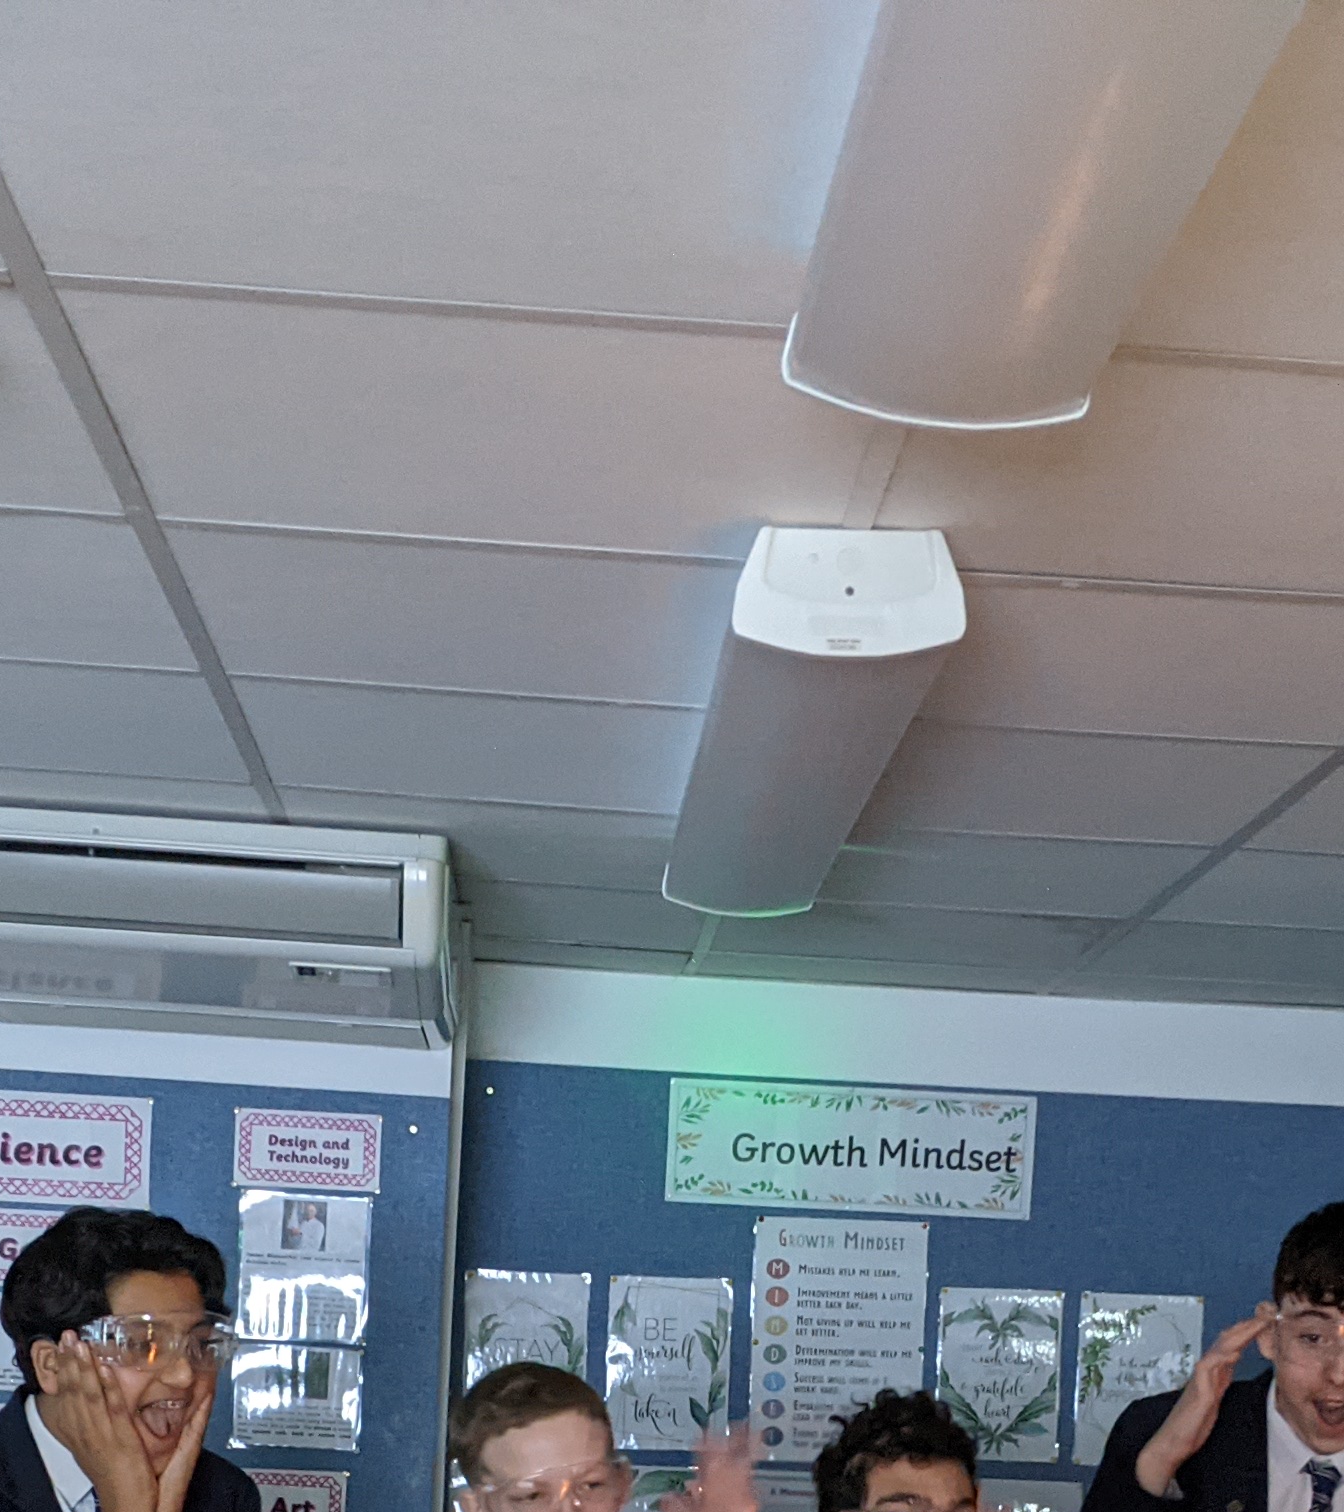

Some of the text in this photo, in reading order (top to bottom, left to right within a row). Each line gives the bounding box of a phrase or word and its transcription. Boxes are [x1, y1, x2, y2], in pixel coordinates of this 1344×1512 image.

[267, 1134, 351, 1152] Design and
[731, 1132, 1018, 1173] Growth Mindset
[267, 1150, 351, 1170] Technology
[644, 1317, 677, 1341] BE
